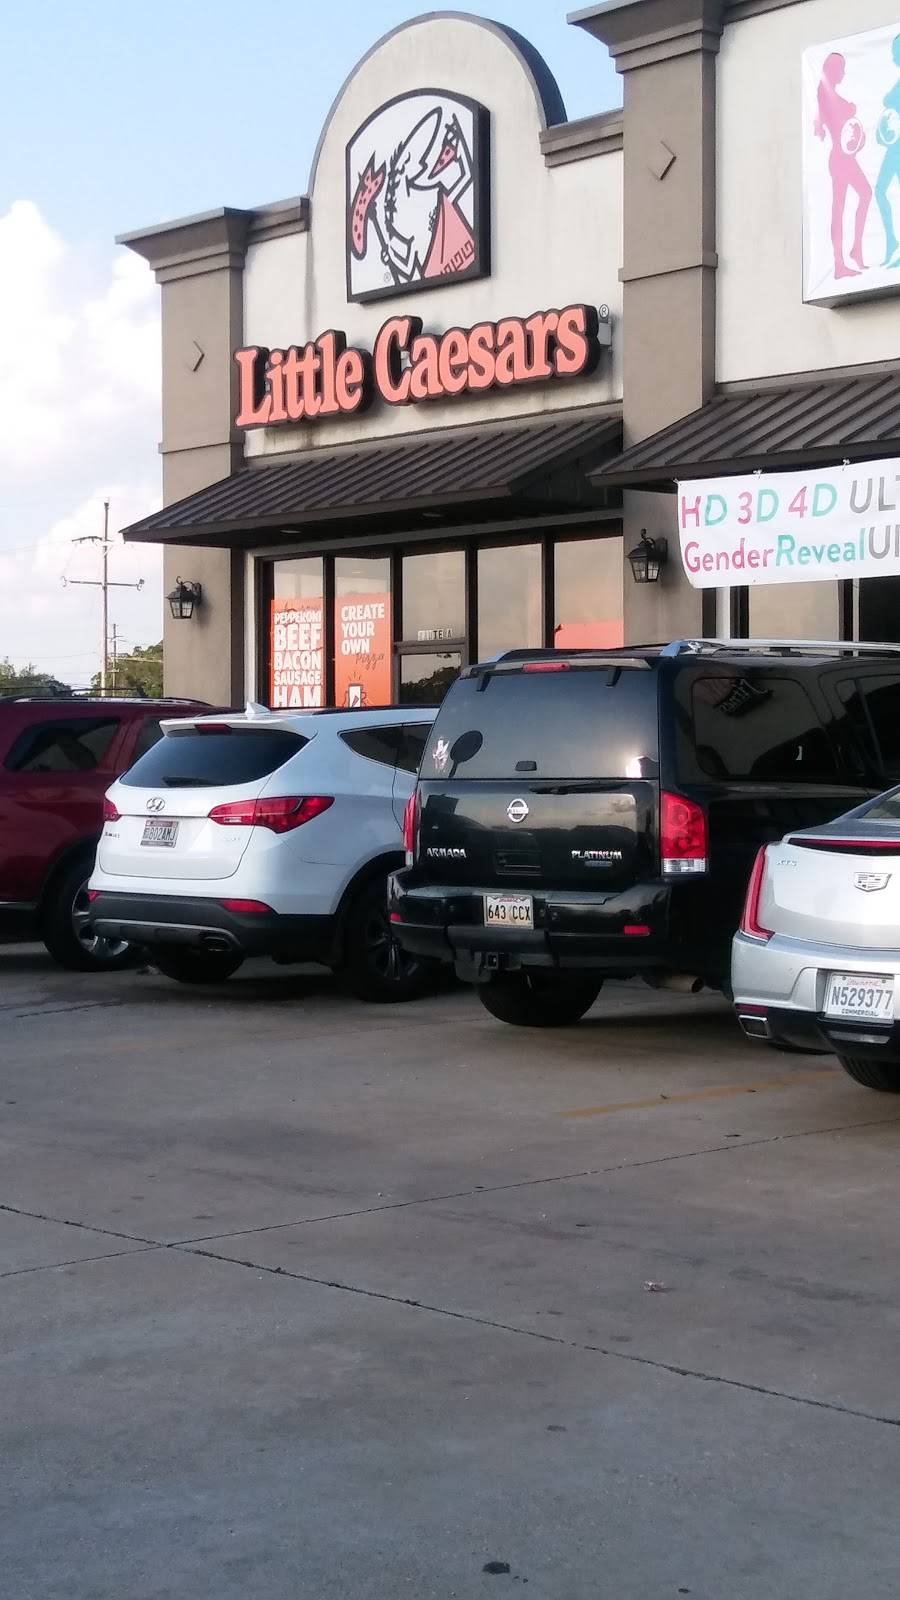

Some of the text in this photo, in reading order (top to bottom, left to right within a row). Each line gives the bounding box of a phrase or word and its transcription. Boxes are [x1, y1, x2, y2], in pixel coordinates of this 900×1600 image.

[234, 304, 589, 427] Little Caesars
[681, 494, 728, 529] HD
[737, 488, 780, 525] 3D
[788, 483, 838, 518] 4D
[341, 603, 385, 621] CREATE
[274, 624, 321, 651] BEEF
[341, 622, 375, 639] YOUR
[341, 639, 370, 655] OWN
[274, 651, 321, 670] BACON
[274, 670, 321, 686] SAUSAGE
[274, 686, 321, 707] HAM
[427, 848, 467, 858] ARMADA
[571, 850, 622, 860] PLATINUM
[488, 905, 531, 921] 643 CCX
[831, 986, 893, 1010] N529377
[841, 1008, 879, 1017] COMMERCIAL
